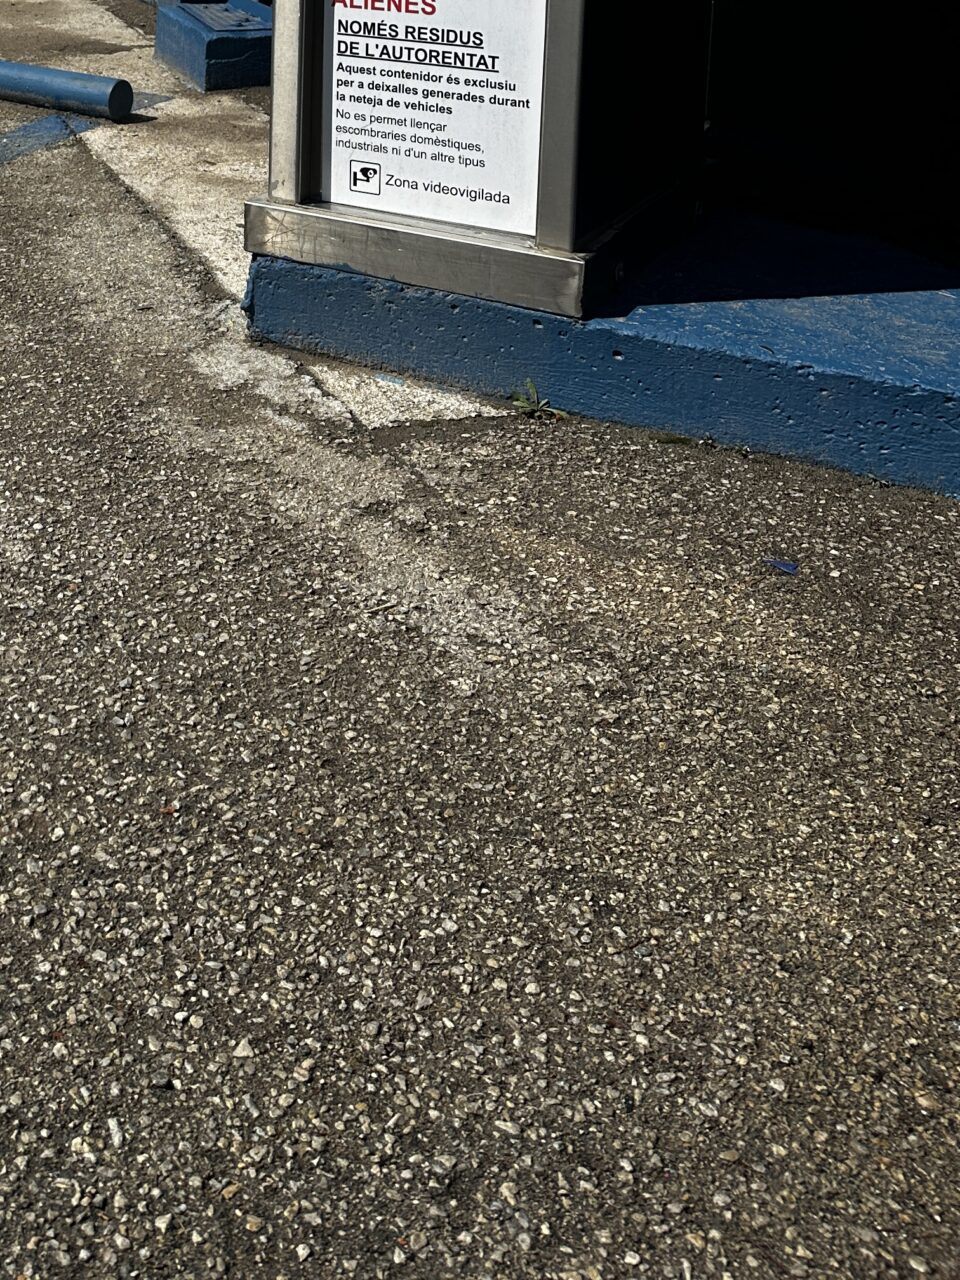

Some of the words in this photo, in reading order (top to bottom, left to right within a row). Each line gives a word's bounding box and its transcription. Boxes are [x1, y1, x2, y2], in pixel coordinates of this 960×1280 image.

[337, 19, 399, 38] NOMÉS
[404, 25, 484, 46] RESIDUS
[337, 40, 360, 56] DE
[365, 42, 499, 70] L'AUTORENTAT
[336, 62, 377, 76] Aquest
[379, 67, 443, 84] contenidor
[446, 73, 461, 85] és
[464, 75, 516, 92] exclusiu
[336, 78, 355, 89] per
[357, 81, 365, 90] a
[367, 80, 418, 96] deixalles
[422, 88, 485, 104] generades
[488, 93, 531, 109] durant
[336, 91, 346, 101] la
[349, 94, 383, 108] neteja
[386, 97, 401, 108] de
[404, 100, 453, 115] vehicles
[335, 108, 351, 120] No
[353, 112, 367, 122] es
[369, 114, 408, 129] permet
[410, 118, 448, 134] llençar
[335, 123, 407, 142] escombraries
[410, 133, 485, 154] domèstiques,
[335, 138, 388, 154] industrials
[391, 145, 401, 156] ni
[404, 147, 427, 160] d'un
[430, 151, 455, 165] altre
[458, 154, 486, 169] tipus
[385, 173, 418, 190] Zona
[422, 180, 511, 205] videovigilada
